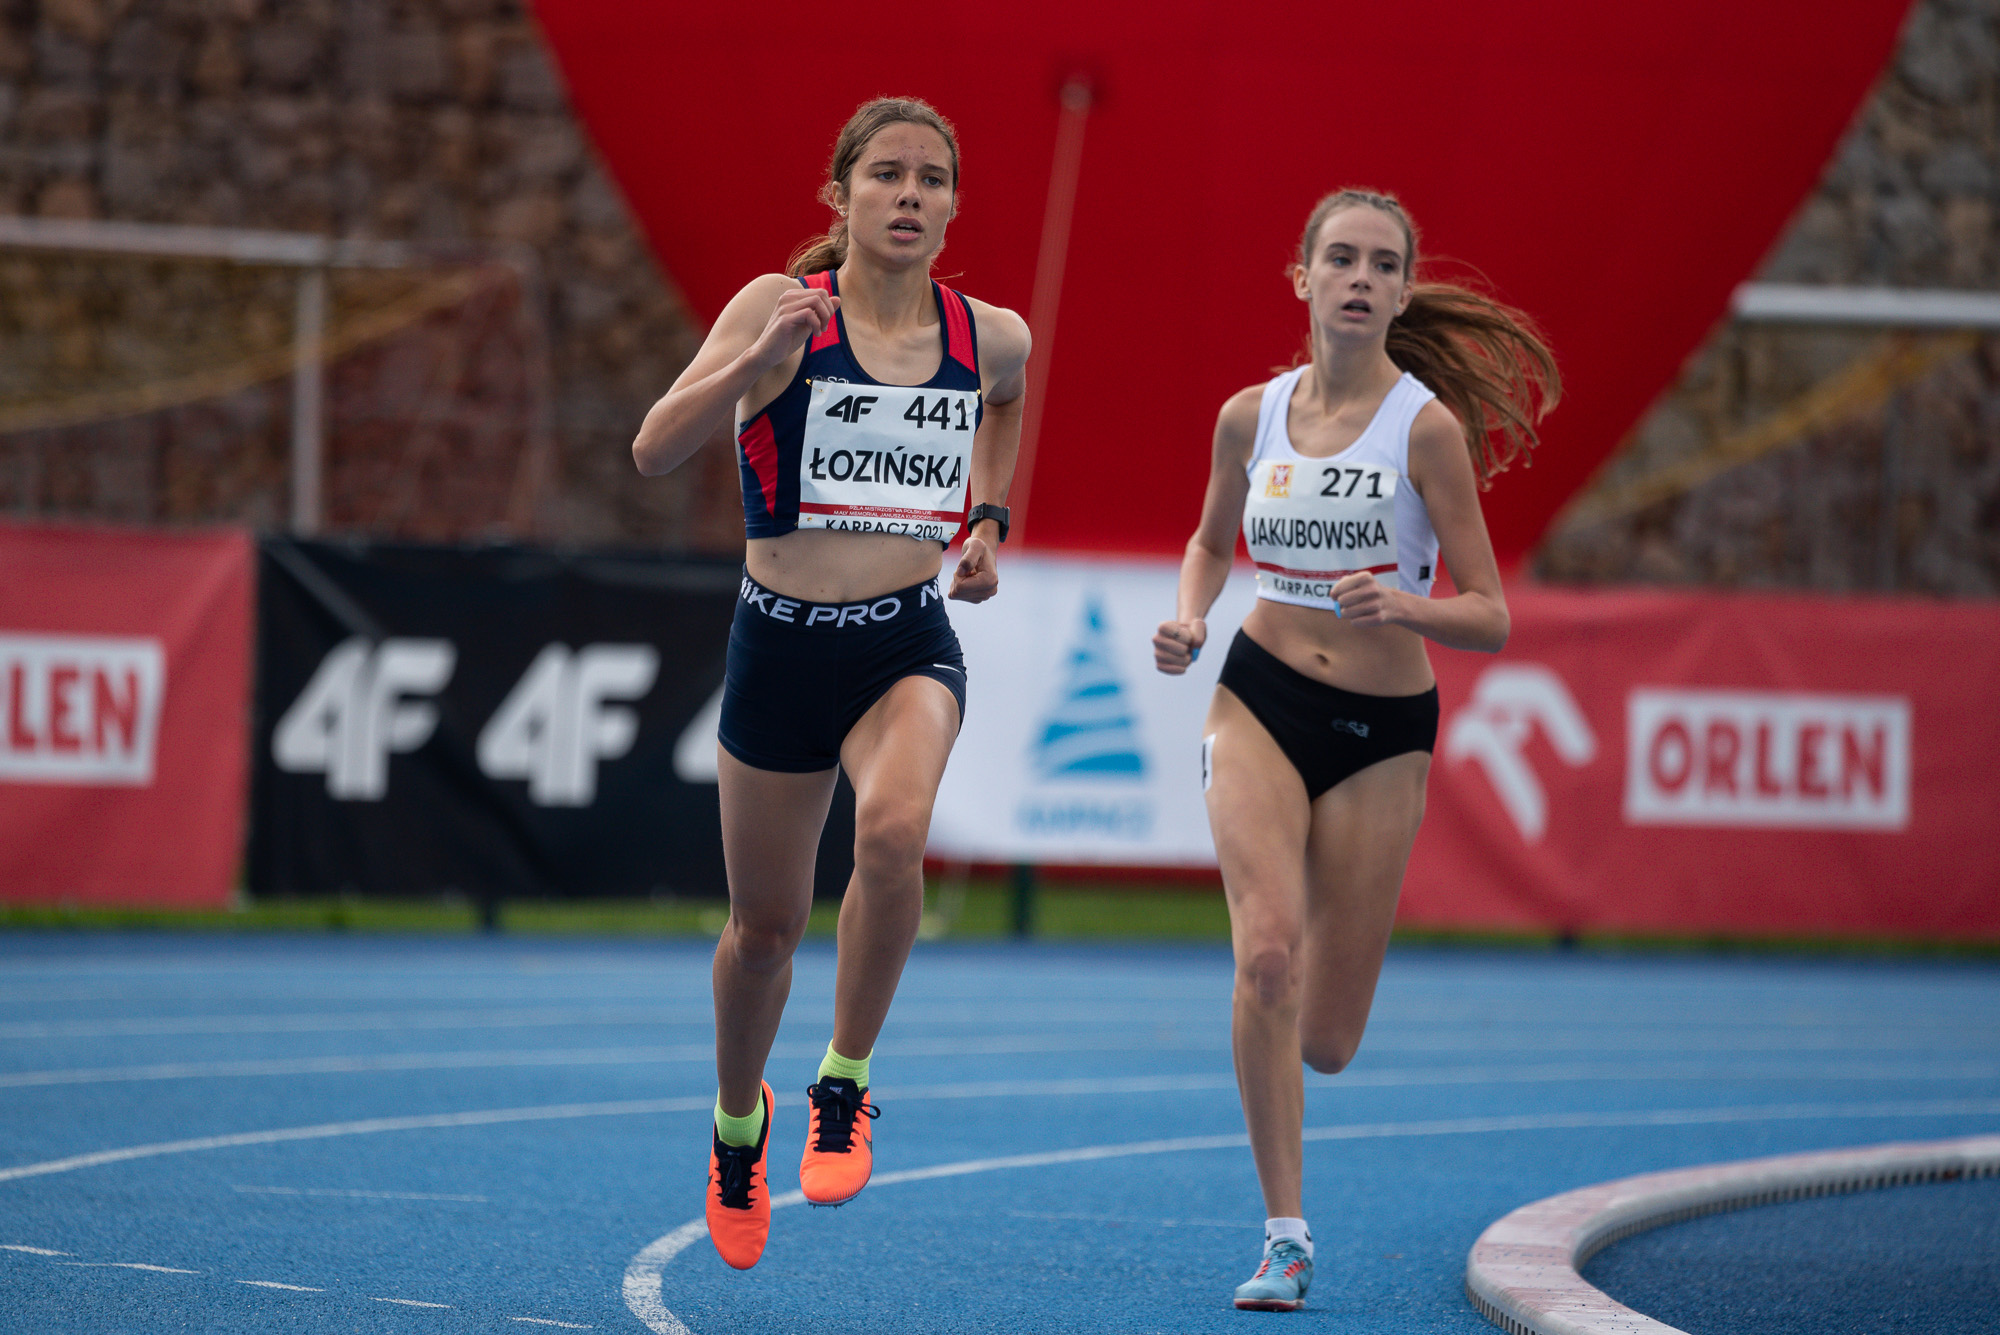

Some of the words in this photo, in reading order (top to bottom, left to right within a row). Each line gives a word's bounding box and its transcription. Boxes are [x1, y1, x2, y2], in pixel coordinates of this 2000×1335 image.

[825, 395, 879, 423] 4F
[903, 395, 969, 431] 441
[808, 445, 962, 489] ŁOZIŃSKA
[1320, 467, 1383, 499] 271
[1251, 517, 1389, 550] JAKUBOWSKA
[805, 597, 901, 628] PRO
[272, 636, 458, 800] 4F
[475, 640, 661, 807] 4F
[1650, 716, 1885, 799] ORLEN
